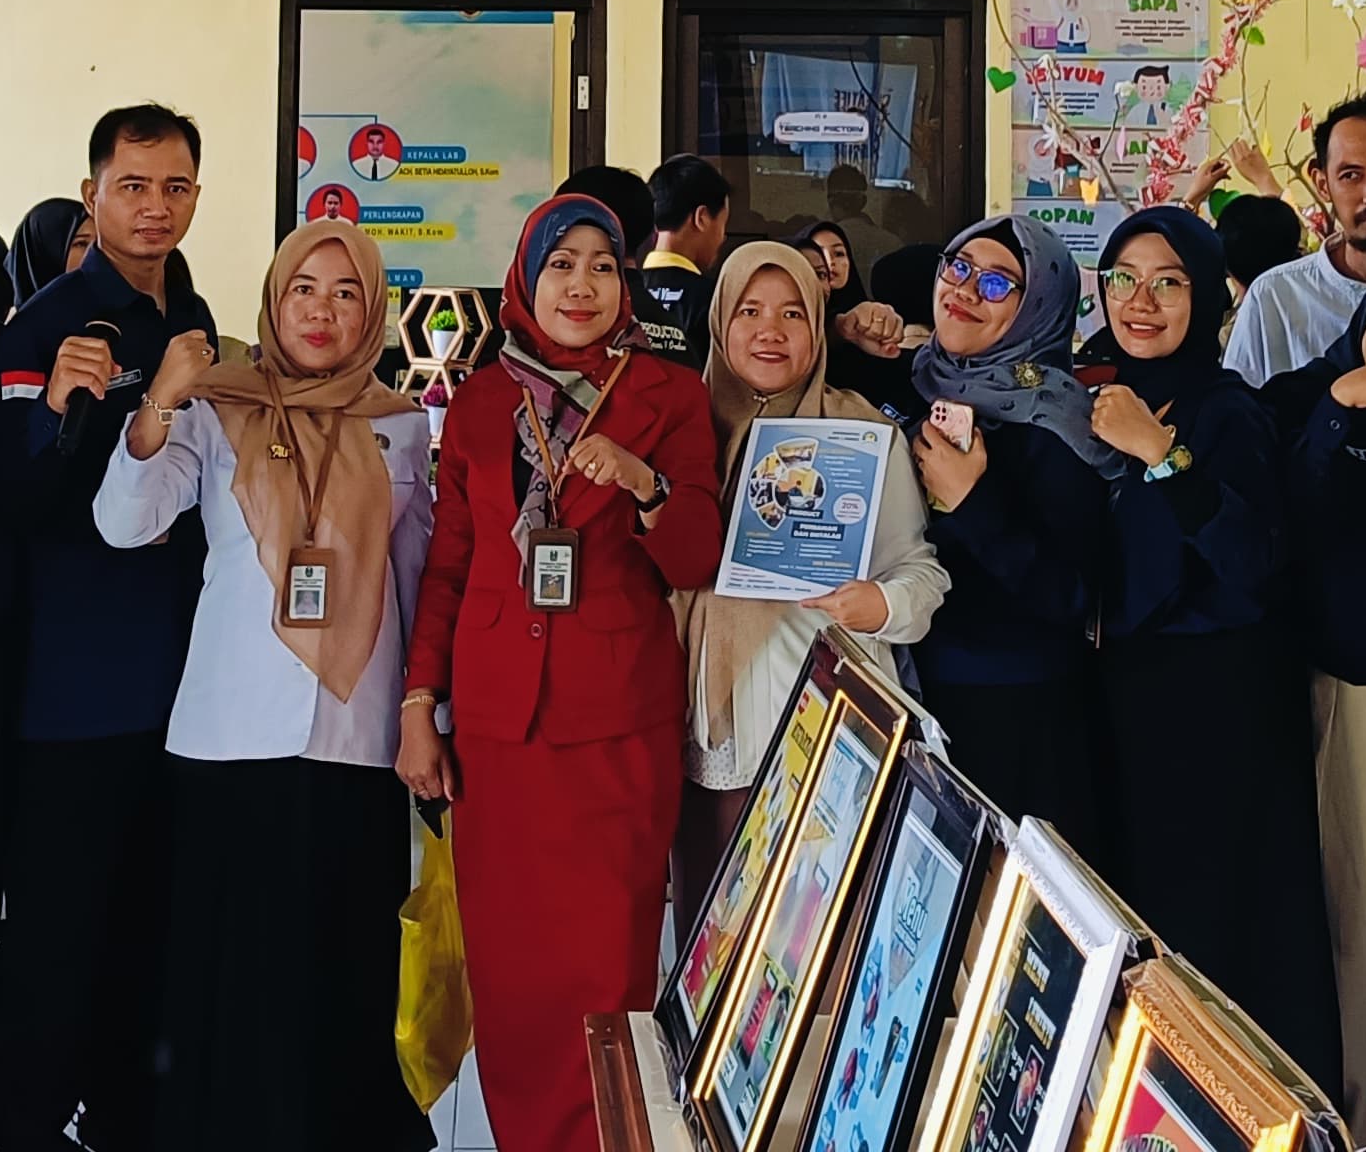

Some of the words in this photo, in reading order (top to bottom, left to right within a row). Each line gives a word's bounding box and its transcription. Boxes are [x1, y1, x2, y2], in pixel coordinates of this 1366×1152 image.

[407, 151, 439, 160] KEPALA
[442, 151, 459, 160] LAB
[363, 210, 421, 220] PERLENGKAPAN
